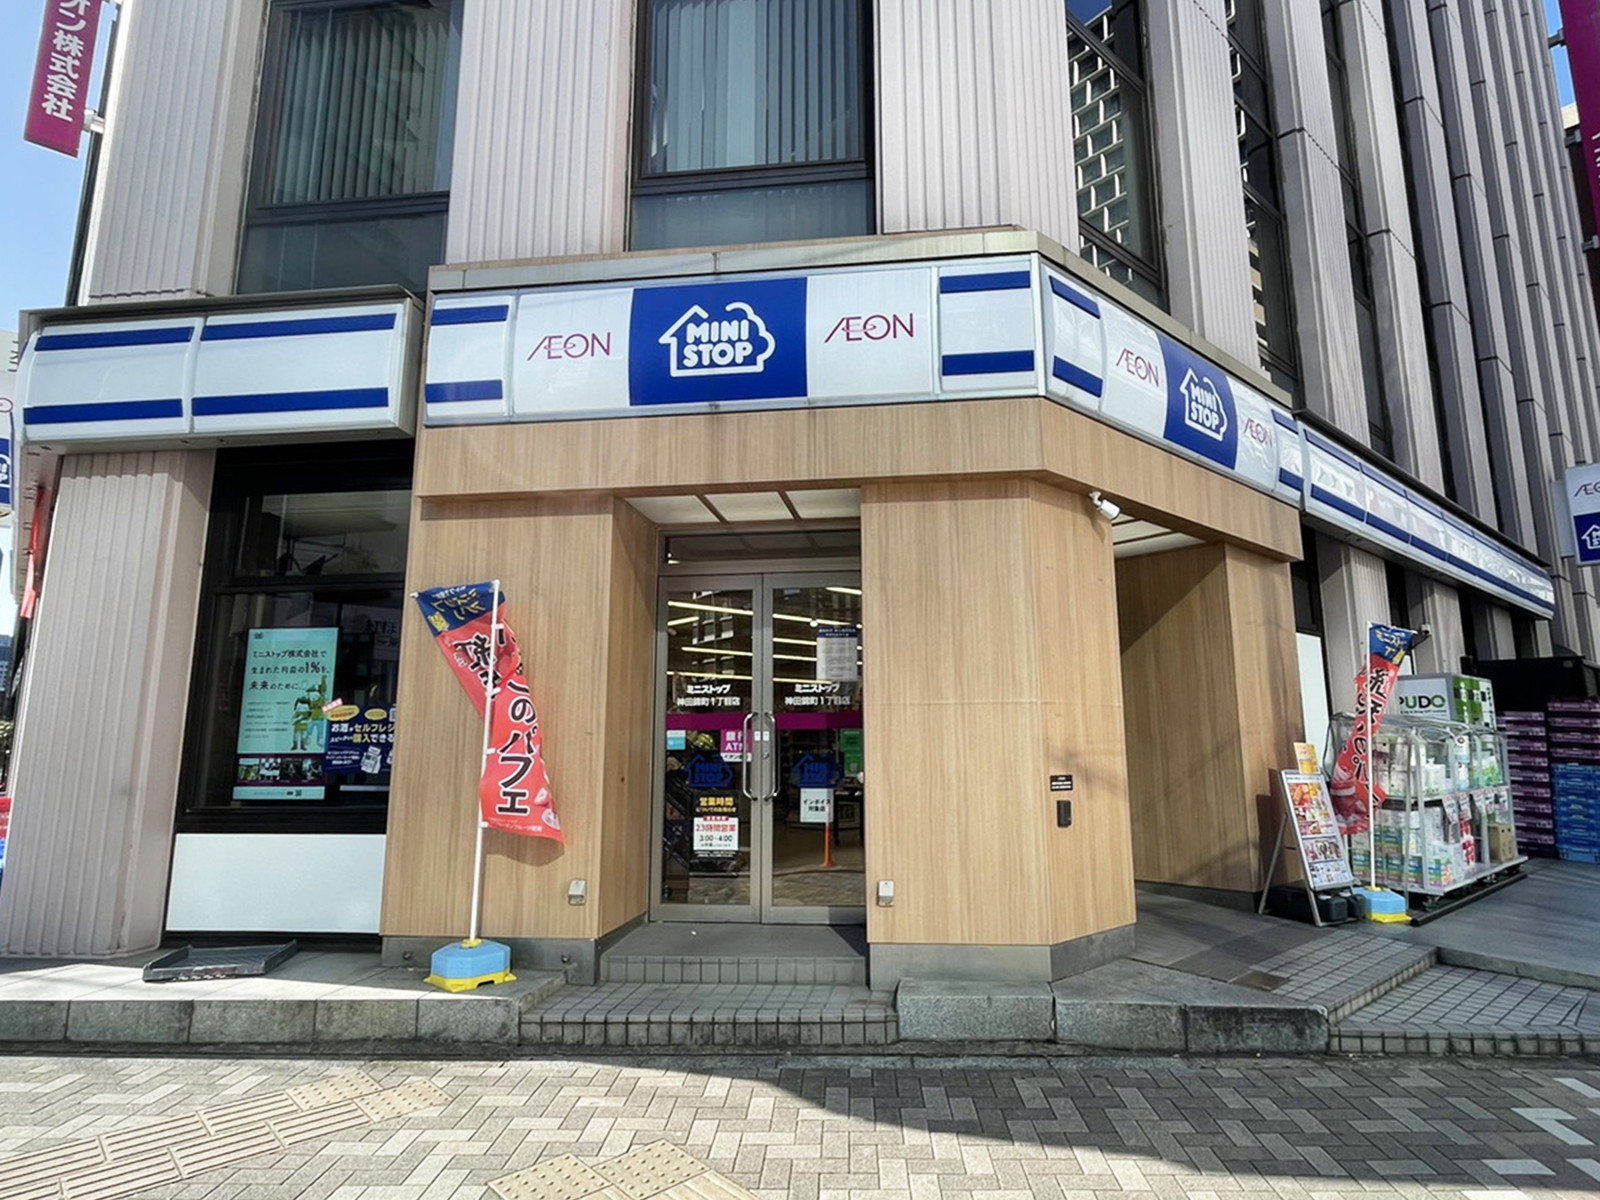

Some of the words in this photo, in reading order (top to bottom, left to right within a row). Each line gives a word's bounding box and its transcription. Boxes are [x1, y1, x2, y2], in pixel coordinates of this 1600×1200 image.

[686, 319, 750, 344] MINI
[823, 313, 914, 343] AEON
[527, 332, 611, 361] AEON
[683, 340, 753, 367] STOP
[1116, 348, 1160, 387] AEON
[1190, 382, 1218, 411] MINI
[1191, 403, 1220, 430] STOP
[687, 684, 731, 694] ミニストップ
[794, 684, 840, 694] ミニストップ
